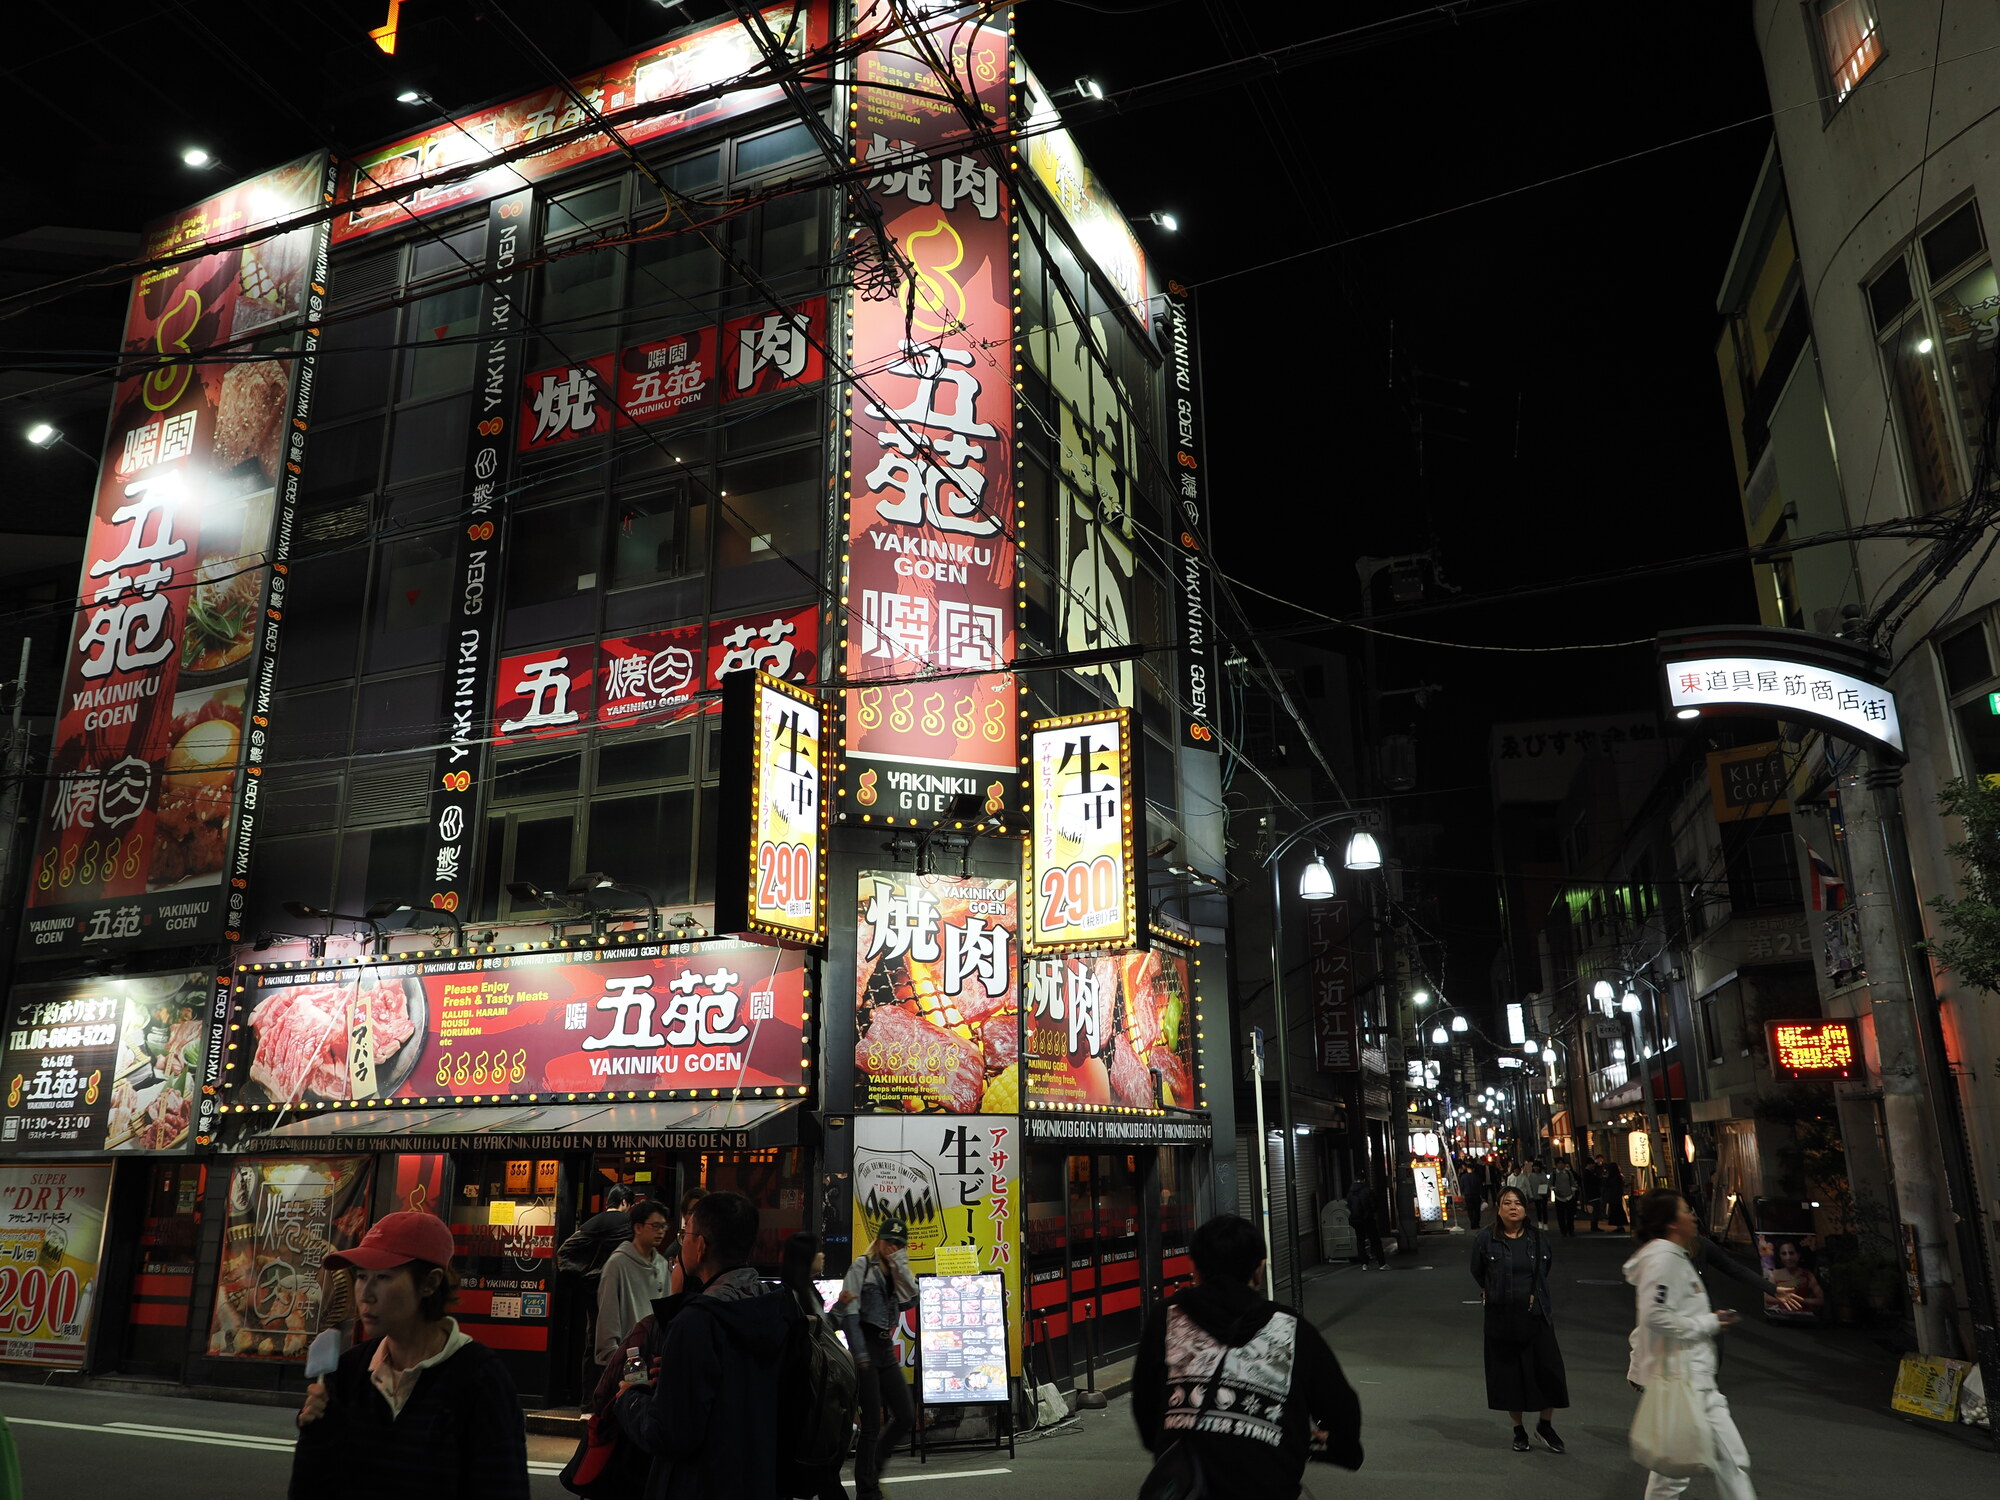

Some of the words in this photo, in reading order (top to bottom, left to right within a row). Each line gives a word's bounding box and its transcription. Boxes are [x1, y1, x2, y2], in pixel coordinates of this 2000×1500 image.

[868, 60, 911, 79] Please
[867, 105, 921, 125] HORUMON
[868, 95, 904, 110] ROUSU
[911, 97, 952, 114] HARAMI
[867, 115, 884, 125] etc
[864, 133, 1001, 220] 焼肉
[182, 213, 208, 230] Enjoy
[185, 224, 212, 240] Tasty
[140, 267, 179, 287] HORUMON
[138, 288, 151, 297] etc
[737, 314, 812, 393] 肉
[1171, 301, 1191, 392] YAKINIKU
[297, 366, 314, 418] YAKINIKU
[625, 361, 705, 408] 五苑
[531, 368, 598, 443] 焼
[627, 399, 671, 417] YAKINIKU
[673, 392, 701, 408] GOEN
[1175, 398, 1193, 447] GOEN
[862, 338, 1004, 538] 五苑
[284, 475, 299, 505] GOEN
[277, 507, 295, 561] YAKINIKU
[870, 531, 992, 566] YAKINIKU
[80, 469, 188, 679] 五苑
[463, 550, 486, 616] GOEN
[894, 556, 968, 585] GOEN
[265, 622, 280, 652] GOEN
[72, 675, 160, 711] YAKINIKU
[257, 656, 275, 713] YAKINIKU
[450, 629, 480, 763] YAKINIKU
[500, 657, 578, 733] 五
[1190, 664, 1208, 719] GOEN
[1678, 670, 1888, 721] 東道具屋筋商店街
[84, 704, 138, 732] GOEN
[606, 700, 657, 716] YAKINIKU
[658, 694, 689, 708] GOEN
[243, 778, 259, 810] GOEN
[886, 770, 977, 796] YAKINIKU
[899, 791, 955, 813] GOE
[236, 814, 254, 875] YAKINIKU
[760, 845, 810, 905] 290
[942, 886, 1006, 902] YAKINIKU
[1044, 859, 1114, 928] 290
[159, 902, 209, 919] YAKINIKU
[968, 900, 1006, 916] GOEN
[29, 917, 76, 935] YAKINIKU
[82, 906, 142, 942] 五苑
[165, 914, 198, 931] GOEN
[36, 930, 64, 945] GOEN
[866, 880, 1011, 998] 焼肉
[264, 975, 293, 986] YAKINIKU
[294, 974, 311, 983] GOEN
[424, 962, 456, 974] YAKINIKU
[457, 961, 475, 971] GOEN
[511, 956, 545, 967] YAKINIKU
[547, 954, 565, 964] GOEN
[603, 949, 638, 960] YAKINIKU
[641, 947, 660, 957] GOEN
[443, 996, 472, 1007] Fresh
[474, 994, 483, 1005] &
[485, 993, 514, 1006] Tasty
[516, 990, 549, 1002] Meats
[444, 984, 479, 995] Please
[481, 981, 510, 994] Enjoy
[214, 988, 228, 1019] GOEN
[442, 1009, 474, 1019] KALUBI.
[475, 1007, 508, 1018] HARAMI
[582, 967, 749, 1050] 五苑
[1028, 959, 1100, 1057] 焼肉
[440, 1026, 482, 1037] HORUMON
[441, 1018, 470, 1029] ROUSU
[1319, 979, 1352, 1067] 近江屋
[206, 1024, 224, 1083] YAKINIKU
[439, 1038, 453, 1047] etc
[40, 1054, 75, 1069] なんば店
[588, 1055, 679, 1076] YAKINIKU
[684, 1052, 742, 1073] GOEN
[26, 1068, 79, 1100] 五苑
[868, 1074, 916, 1085] YAKINIKU
[918, 1075, 947, 1085] GOEN
[868, 1085, 890, 1094] keeps
[891, 1085, 918, 1095] offering
[56, 1100, 75, 1109] GOEN
[868, 1092, 901, 1101] delicious
[902, 1093, 918, 1101] menu
[369, 1136, 421, 1150] YAKINIKU
[483, 1134, 541, 1150] YAKINIKU
[552, 1134, 593, 1149] GOEN
[612, 1134, 674, 1149] YAKINIKU
[687, 1133, 732, 1148] GOEN
[1031, 1119, 1068, 1137] YAKINIKU
[1075, 1121, 1097, 1138] GOEN
[1105, 1122, 1134, 1139] YAKINIKU
[1139, 1123, 1158, 1139] GOEN
[1163, 1124, 1187, 1139] YAKINIKU
[1191, 1124, 1207, 1139] GOEN
[30, 1173, 68, 1185] SUPER
[898, 1165, 918, 1184] LIMITED
[8, 1212, 73, 1224] アサヒスーパードライ
[865, 1185, 935, 1226] Asahi
[486, 1278, 519, 1289] YAKINIKU
[520, 1280, 538, 1290] GOEN
